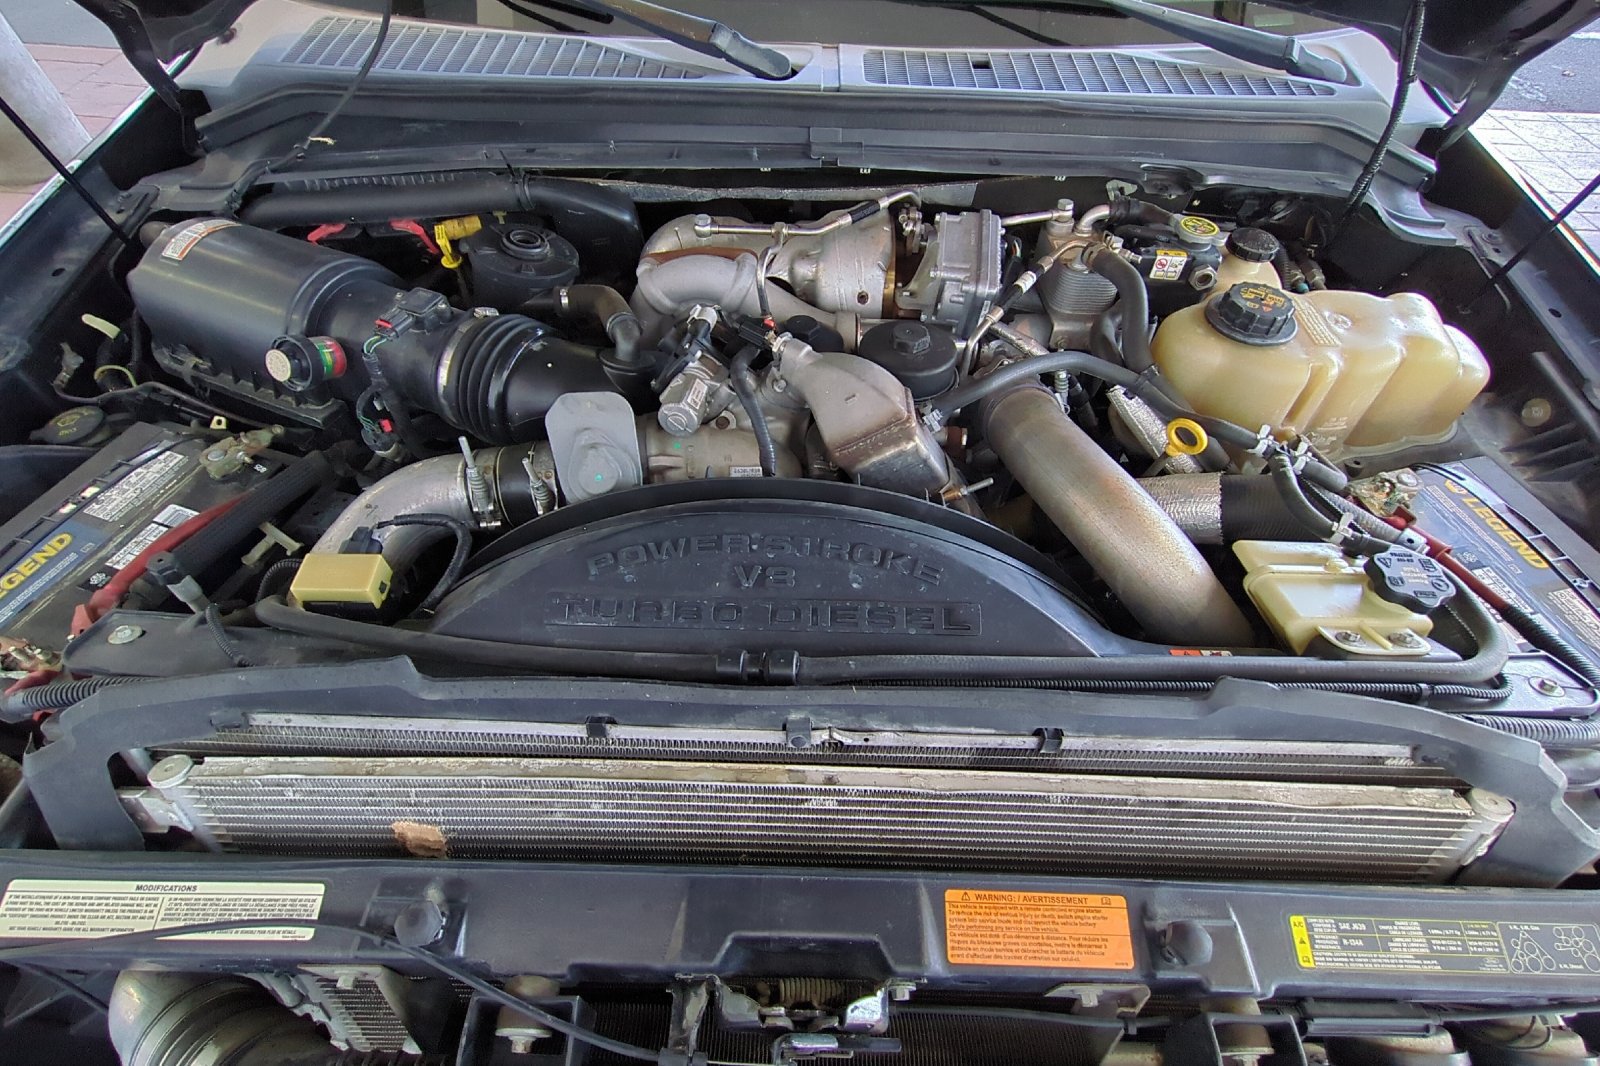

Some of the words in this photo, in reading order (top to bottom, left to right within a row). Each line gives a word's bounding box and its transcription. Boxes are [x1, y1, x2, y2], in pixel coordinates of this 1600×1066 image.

[1463, 498, 1548, 569] LEGEND
[0, 533, 72, 598] GEND
[733, 565, 796, 587] V8
[553, 597, 743, 624] TURBO
[767, 602, 972, 631] DIESEL
[975, 893, 1016, 902] WARNING:
[1023, 895, 1088, 905] AVERTISSEMENT
